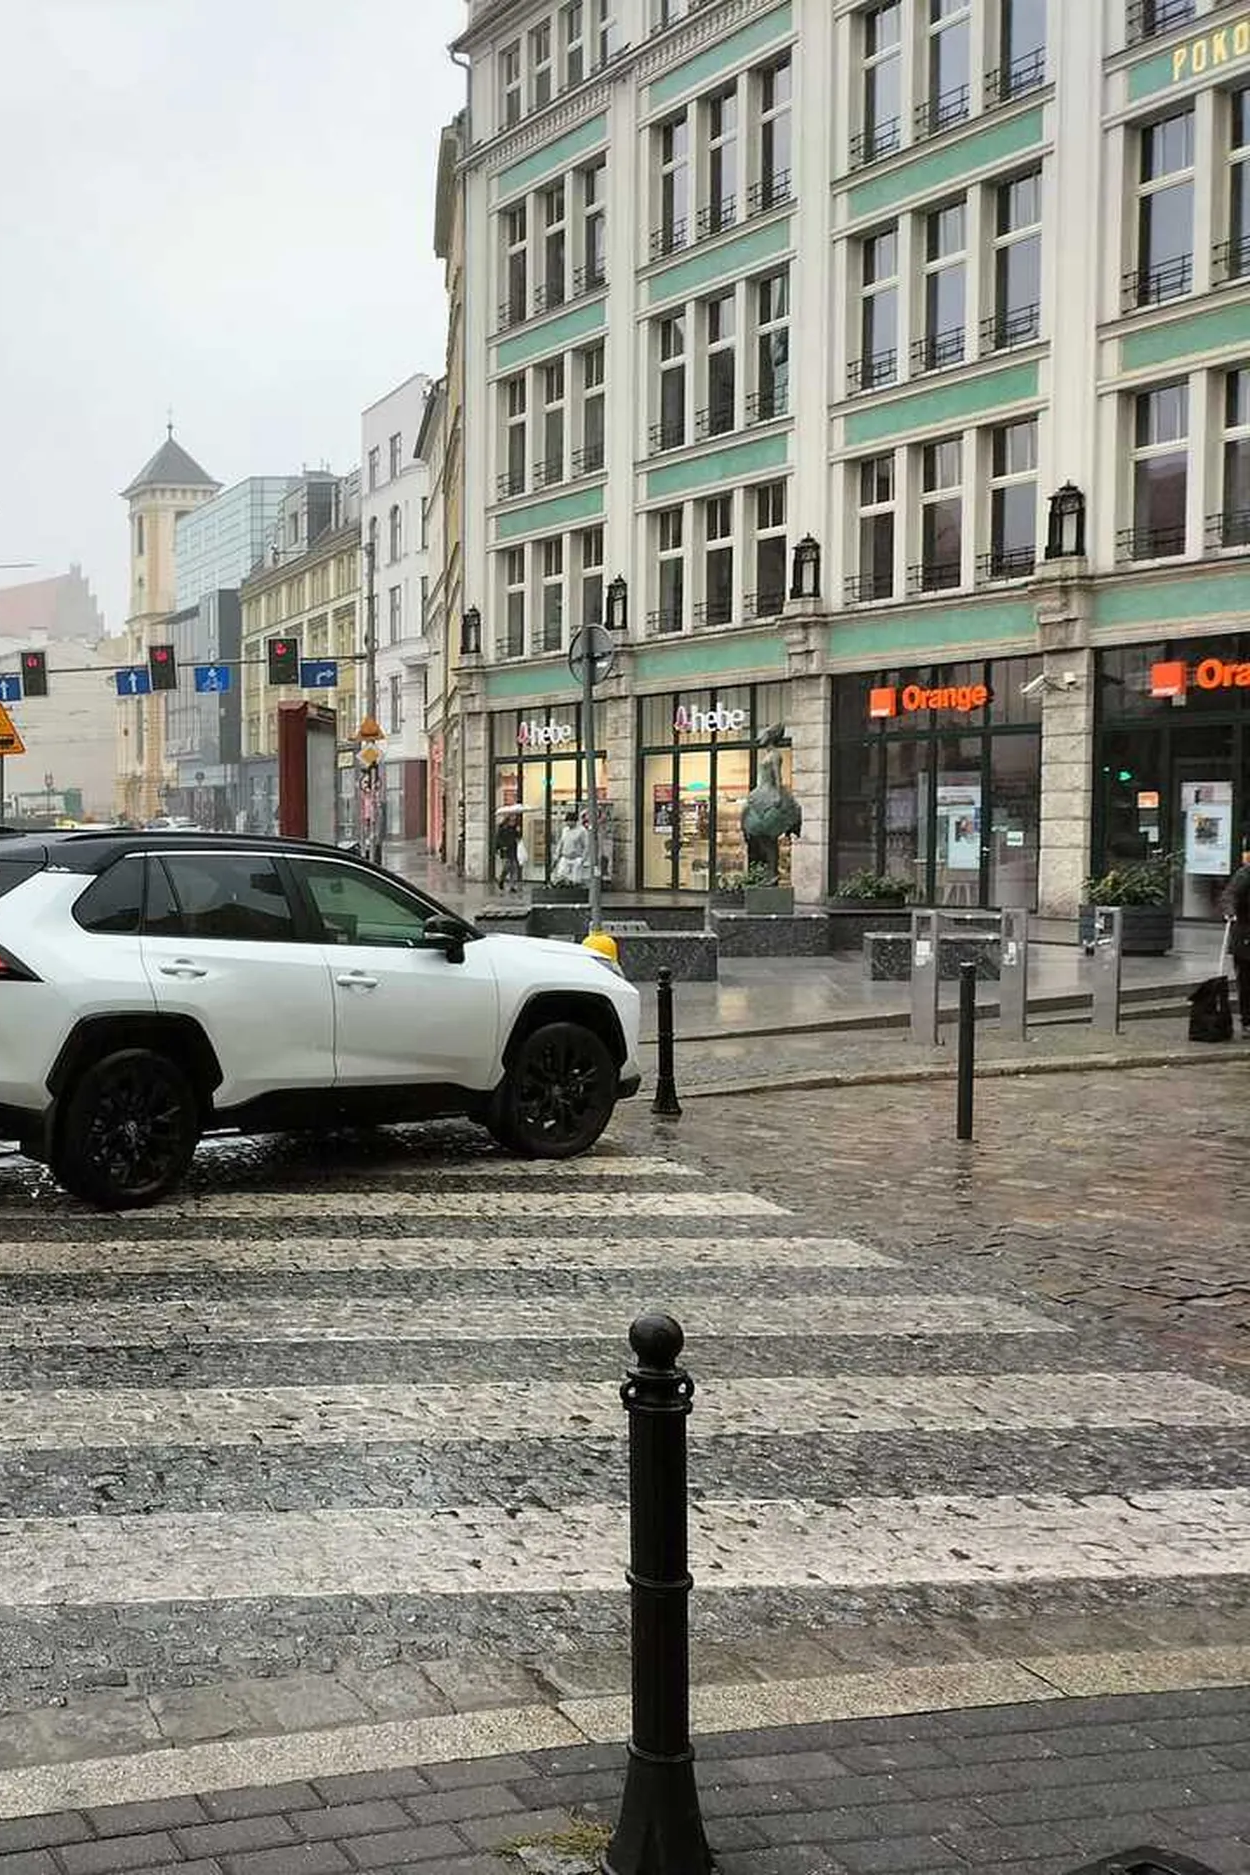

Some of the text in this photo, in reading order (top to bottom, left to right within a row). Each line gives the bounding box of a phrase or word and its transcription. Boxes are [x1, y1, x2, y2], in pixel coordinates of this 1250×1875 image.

[1172, 22, 1250, 81] POKO
[902, 684, 987, 711] Orange
[691, 702, 745, 732] hebe
[531, 718, 571, 746] hebe
